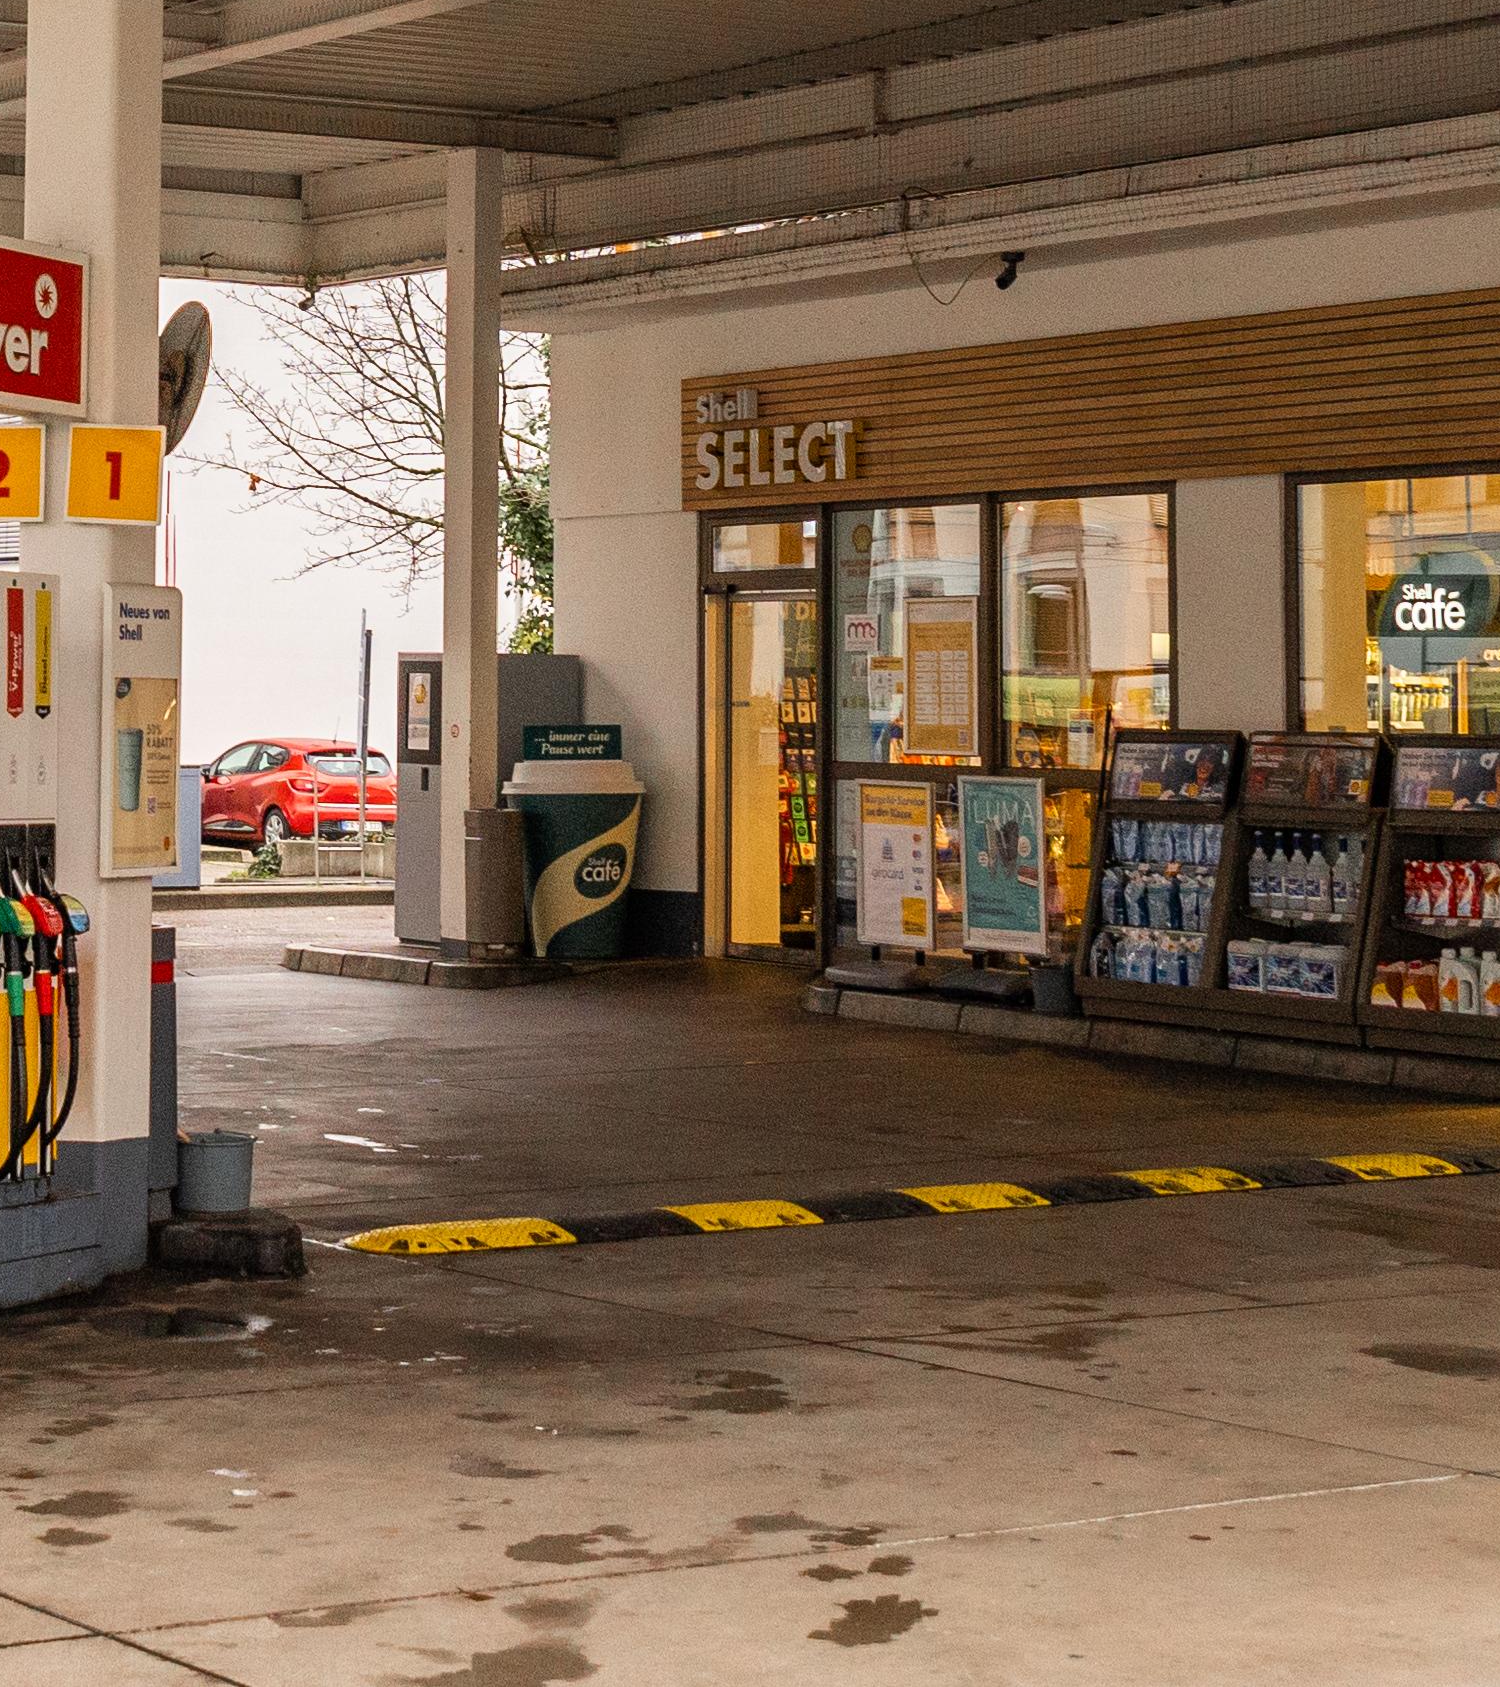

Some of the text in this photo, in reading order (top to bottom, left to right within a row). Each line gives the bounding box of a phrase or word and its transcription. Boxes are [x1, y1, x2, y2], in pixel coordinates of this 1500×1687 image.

[695, 386, 757, 424] Shell
[695, 420, 853, 491] SELECT
[105, 451, 122, 500] 1
[1401, 583, 1433, 600] Shell
[119, 603, 171, 620] Neues von
[1394, 588, 1466, 631] café
[119, 625, 143, 641] Shell
[549, 730, 585, 742] immer
[588, 730, 610, 742] eine
[541, 743, 604, 755] Pause wert
[582, 859, 621, 882] café
